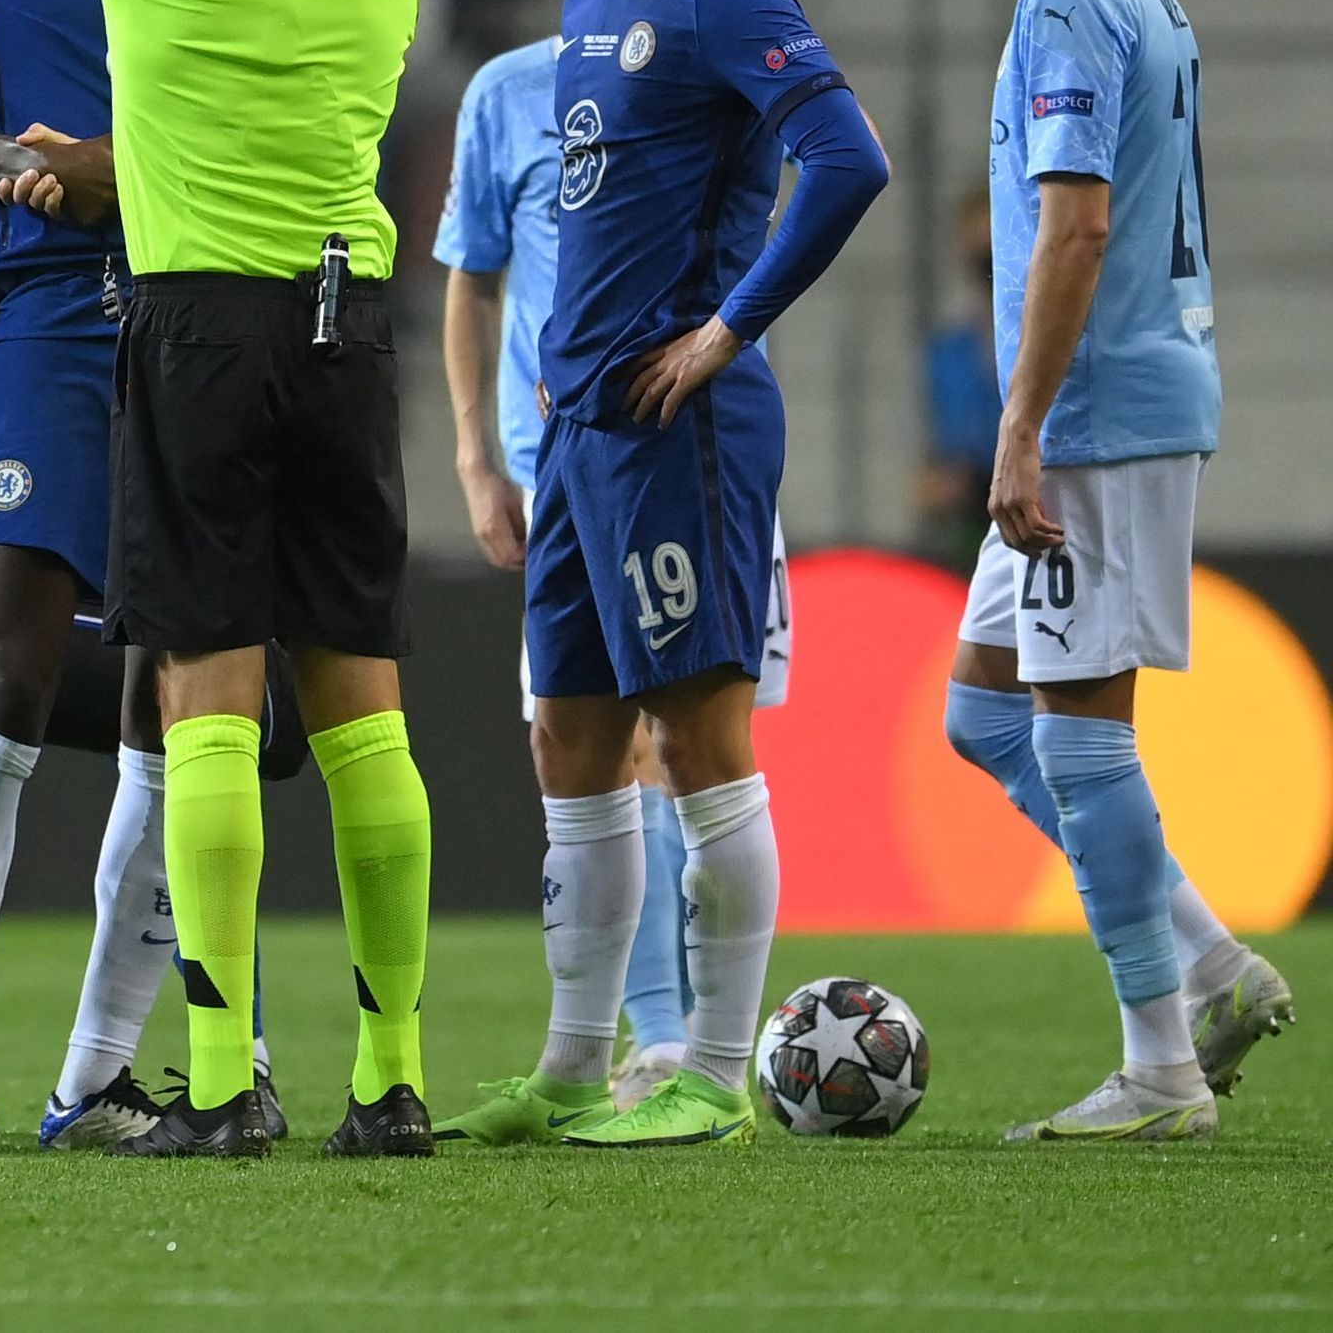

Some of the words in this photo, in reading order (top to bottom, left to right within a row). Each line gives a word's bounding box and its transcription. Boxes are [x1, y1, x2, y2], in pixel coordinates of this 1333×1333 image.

[1046, 96, 1093, 110] RESPECT
[624, 542, 699, 630] 19
[1020, 546, 1074, 610] 26
[390, 1124, 425, 1136] COPA
